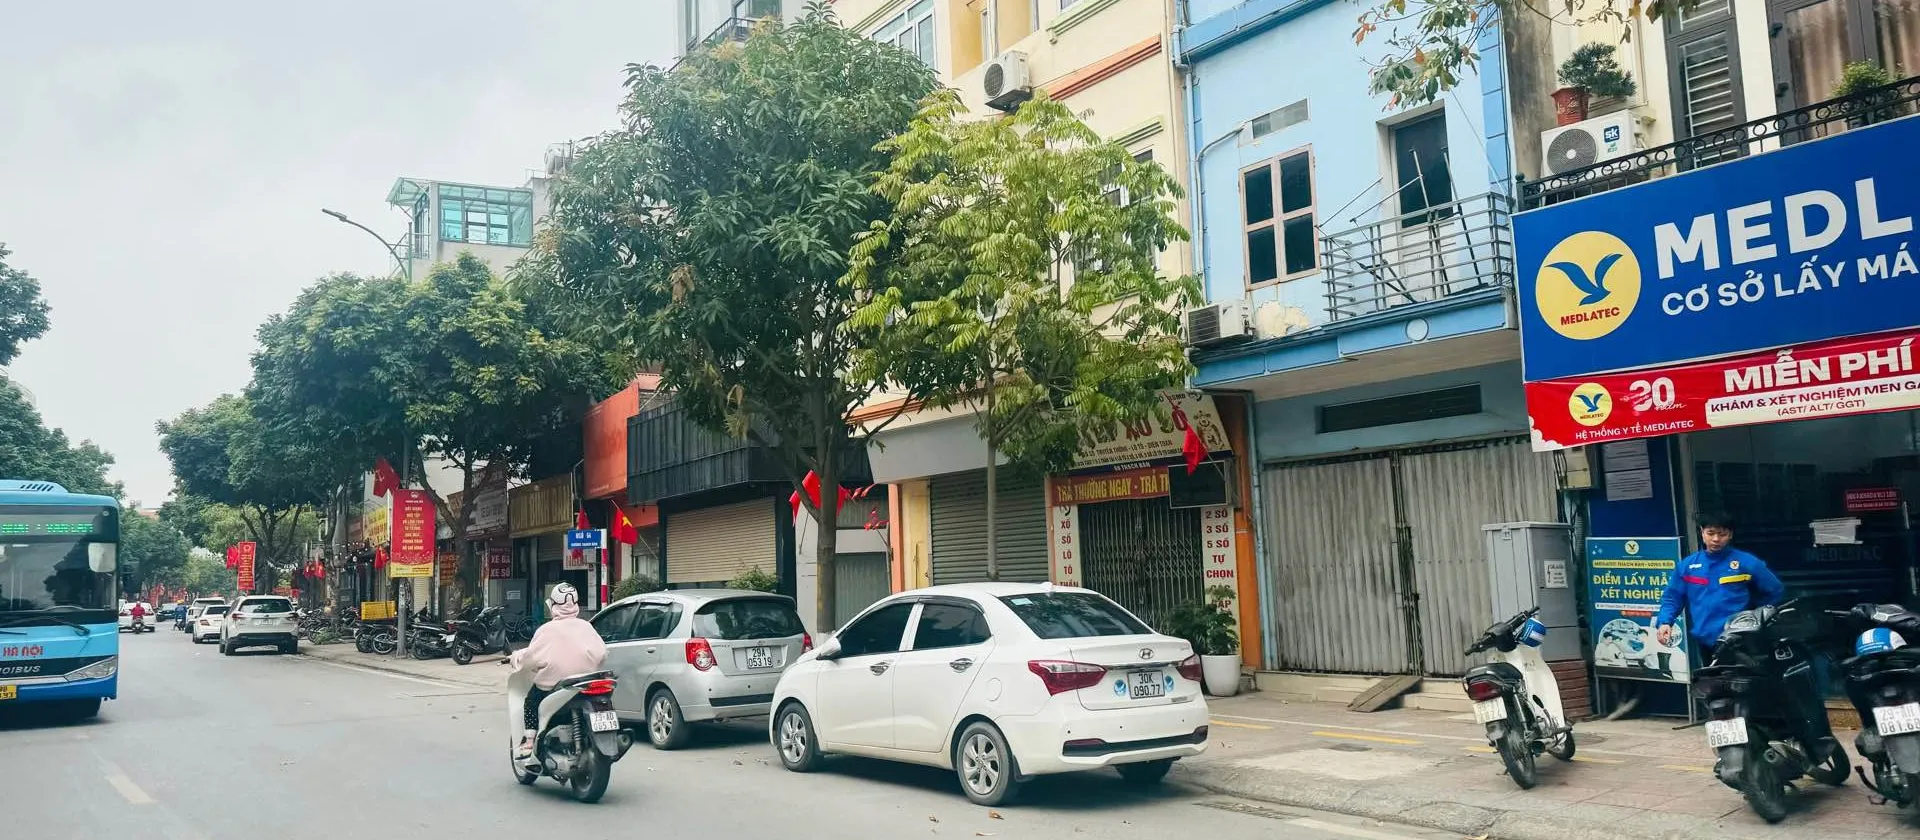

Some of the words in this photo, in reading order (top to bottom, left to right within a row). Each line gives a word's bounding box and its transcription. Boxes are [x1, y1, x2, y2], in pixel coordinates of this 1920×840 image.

[1654, 177, 1913, 280] MEDL
[1661, 283, 1710, 316] CƠ
[1717, 269, 1766, 307] SỞ
[1774, 254, 1846, 298] LẤY
[1856, 242, 1920, 283] MÁ
[1560, 306, 1620, 326] MEDLATEC
[1724, 348, 1831, 393] MIỄN
[1838, 337, 1916, 379] PHÍ
[1710, 398, 1754, 413] KHÁM
[1756, 397, 1767, 407] &
[1769, 392, 1794, 406] XÉT
[1799, 386, 1861, 402] NGHIỆM
[1863, 382, 1901, 395] MEN
[1575, 431, 1588, 441] HỆ
[1588, 425, 1621, 438] THỐNG
[1630, 421, 1642, 434] TẾ
[1643, 419, 1694, 434] MEDLATEC
[1057, 479, 1073, 502] TRẢ
[1074, 478, 1108, 501] THƯỞNG
[1109, 477, 1132, 497] NGAY
[1140, 468, 1158, 494] TRẢ
[1205, 510, 1213, 519] 2
[1214, 507, 1228, 519] SỐ
[1206, 525, 1213, 534] 3
[1215, 523, 1229, 533] SỐ
[1061, 532, 1072, 544] SỐ
[1207, 540, 1213, 548] 5
[1216, 537, 1230, 548] SỐ
[1062, 550, 1072, 560] LÔ
[1212, 554, 1225, 565] TỰ
[1063, 564, 1073, 575] TÔ
[1206, 569, 1234, 580] CHỌN
[1593, 570, 1621, 585] ĐIỂM
[1624, 571, 1645, 586] LẤY
[1649, 571, 1672, 586] MẪ
[1601, 586, 1621, 598] XÉT
[1623, 587, 1664, 602] NGHIỆ
[752, 647, 766, 658] 29A
[1138, 673, 1153, 684] 30K
[1134, 684, 1160, 696] 090.77
[1710, 731, 1745, 746] 885.28
